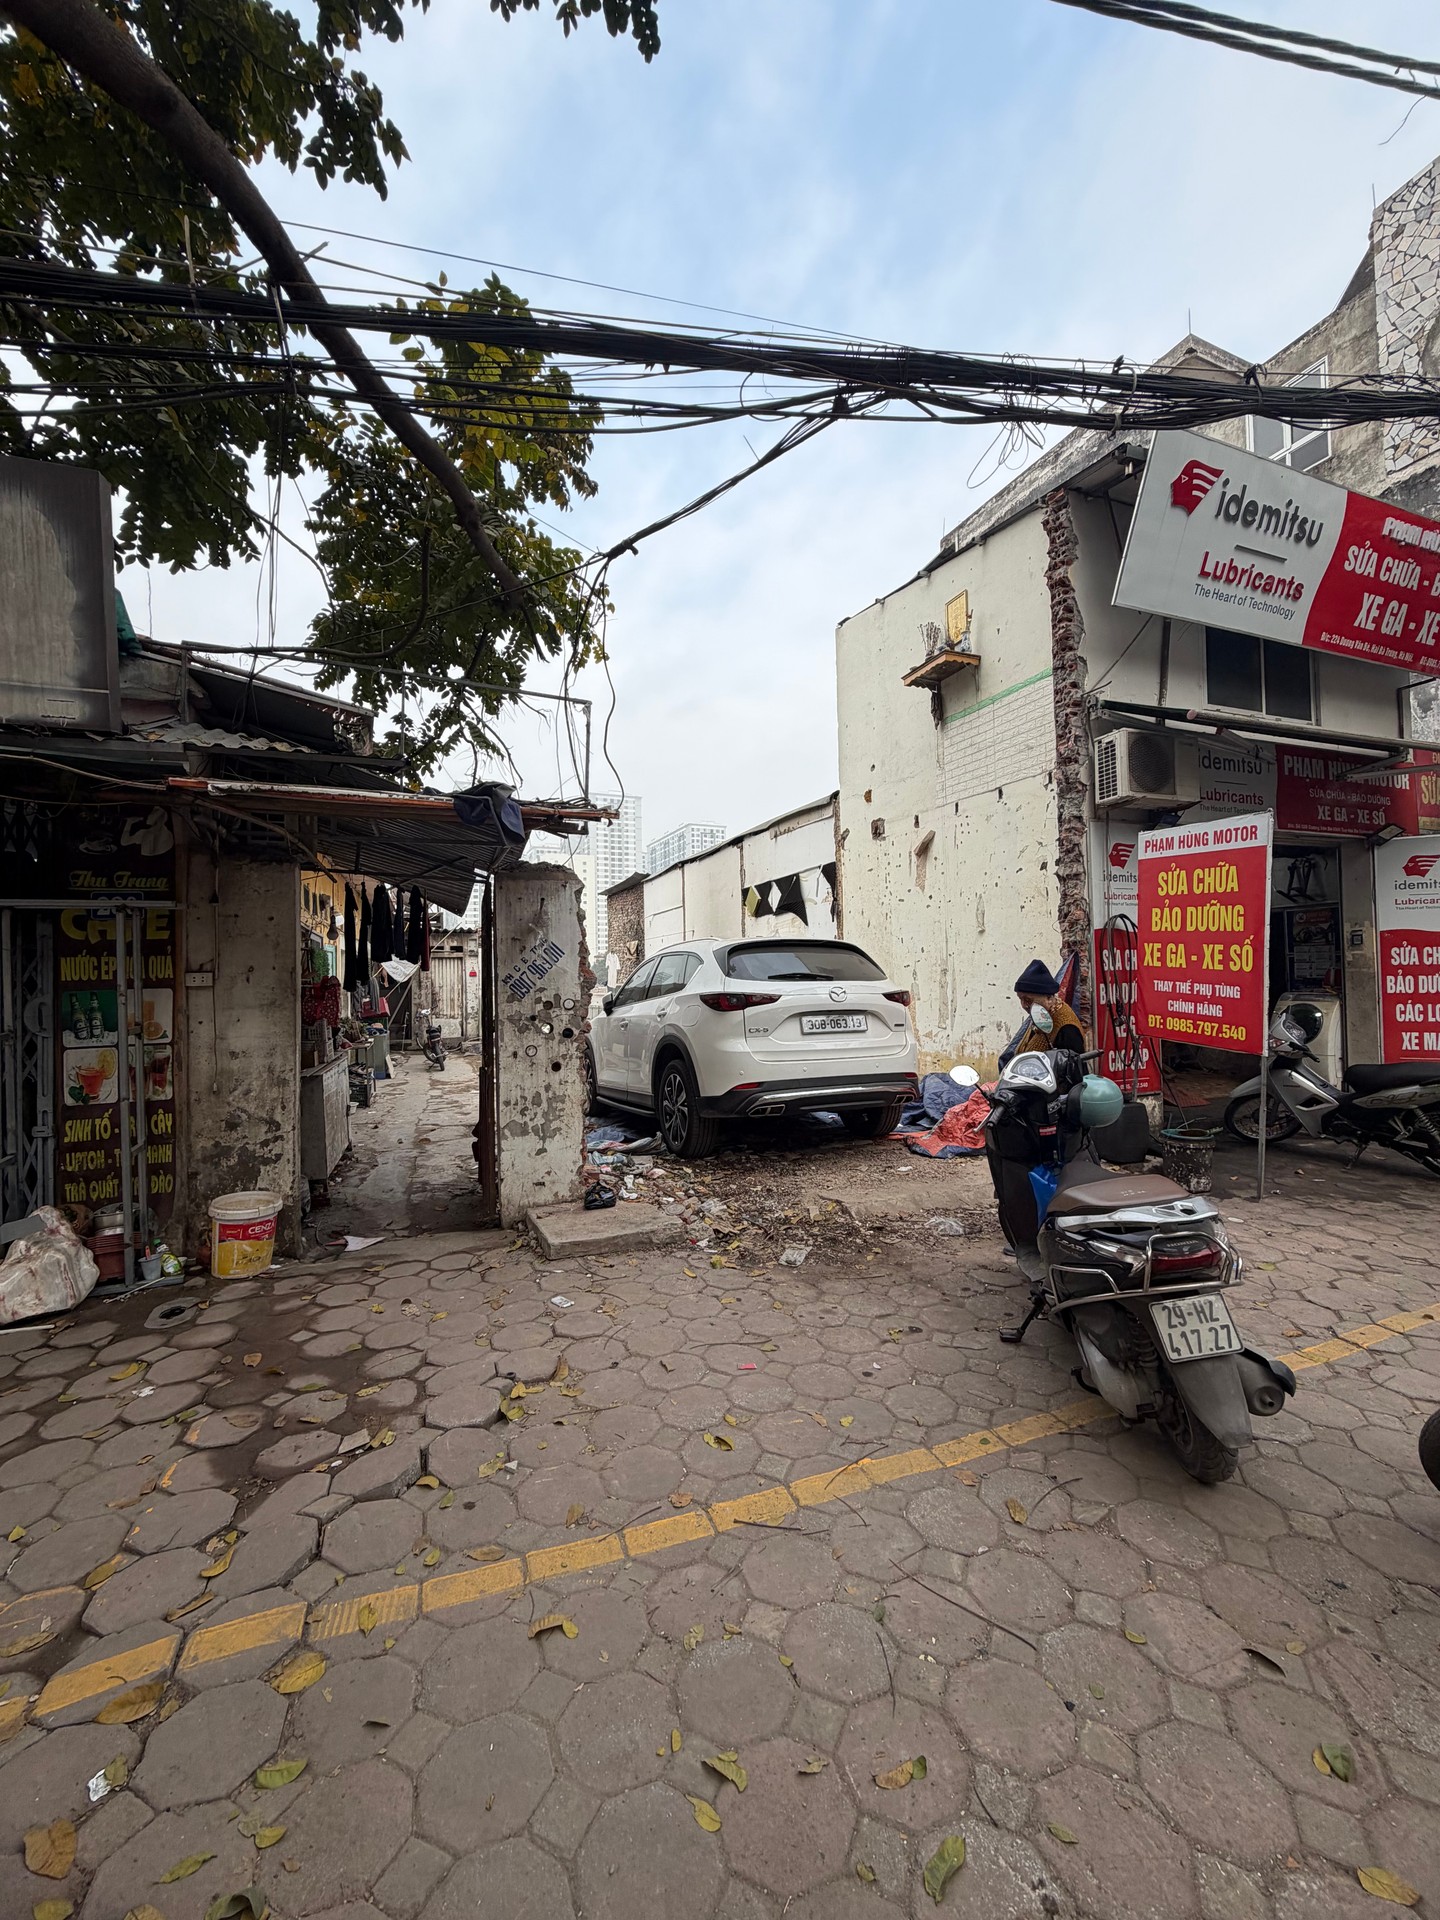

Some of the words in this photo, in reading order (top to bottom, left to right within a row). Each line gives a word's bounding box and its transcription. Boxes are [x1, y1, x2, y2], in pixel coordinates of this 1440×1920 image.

[1215, 477, 1324, 547] idemitsu
[1420, 529, 1440, 554] HÙ
[1198, 551, 1305, 601] Lubricants
[1343, 540, 1379, 578] SỬA
[1379, 556, 1422, 591] CHỮA
[1430, 572, 1440, 597] B
[1194, 583, 1211, 598] The
[1211, 588, 1237, 605] Heart
[1237, 596, 1248, 606] of
[1248, 597, 1296, 621] Technology
[1353, 592, 1385, 631] XE
[1381, 600, 1409, 638] GA
[1415, 610, 1440, 646] XE
[1198, 748, 1262, 775] idemitsu
[1284, 754, 1325, 782] PHẠM
[1200, 786, 1264, 806] Lubricants
[1210, 805, 1227, 813] Heart
[1317, 805, 1332, 820] XE
[1333, 806, 1348, 822] GA
[1357, 808, 1370, 824] XE
[1372, 806, 1386, 826] SỐ
[1144, 836, 1175, 855] PHẠM
[1178, 830, 1209, 849] HÙNG
[1213, 825, 1258, 846] MOTOR
[69, 870, 109, 889] Thu
[113, 870, 169, 889] Trang
[1103, 870, 1137, 883] idemits
[1157, 862, 1188, 896] SỬA
[1193, 861, 1239, 894] CHỮA
[1394, 878, 1440, 891] idemit
[1104, 892, 1139, 900] Lubricant
[1151, 899, 1182, 932] BẢO
[1186, 899, 1245, 932] DƯỠNG
[60, 950, 98, 982] NƯỚC
[100, 951, 117, 980] ÉP
[148, 946, 174, 980] QUẢ
[1124, 949, 1138, 971] CH
[1143, 943, 1162, 967] XE
[1166, 943, 1187, 968] GA
[1202, 943, 1224, 970] XE
[1229, 935, 1254, 972] SỐ
[1390, 941, 1419, 965] SỬA
[1423, 947, 1440, 965] CH
[508, 970, 537, 1000] 0917
[1153, 980, 1173, 992] THAY
[1175, 979, 1192, 994] THẾ
[1193, 983, 1212, 998] PHỤ
[1214, 982, 1241, 999] TÙNG
[1386, 969, 1415, 993] BẢO
[1167, 999, 1194, 1014] CHÍNH
[1196, 1001, 1223, 1017] HÃNG
[1395, 1000, 1423, 1022] CÁC
[1148, 1014, 1164, 1029] ĐT:
[1166, 1017, 1246, 1041] 0985.797.540
[1402, 1032, 1419, 1051] XE
[63, 1118, 92, 1144] SINH
[95, 1108, 113, 1141] TỐ
[150, 1108, 173, 1135] CÂY
[64, 1177, 87, 1203] TRÀ
[89, 1171, 120, 1202] QUẤT
[150, 1169, 174, 1195] ĐÀO
[1055, 1237, 1086, 1252] LEAD
[1166, 1239, 1199, 1248] HONDA
[1167, 1323, 1233, 1357] 417.27
